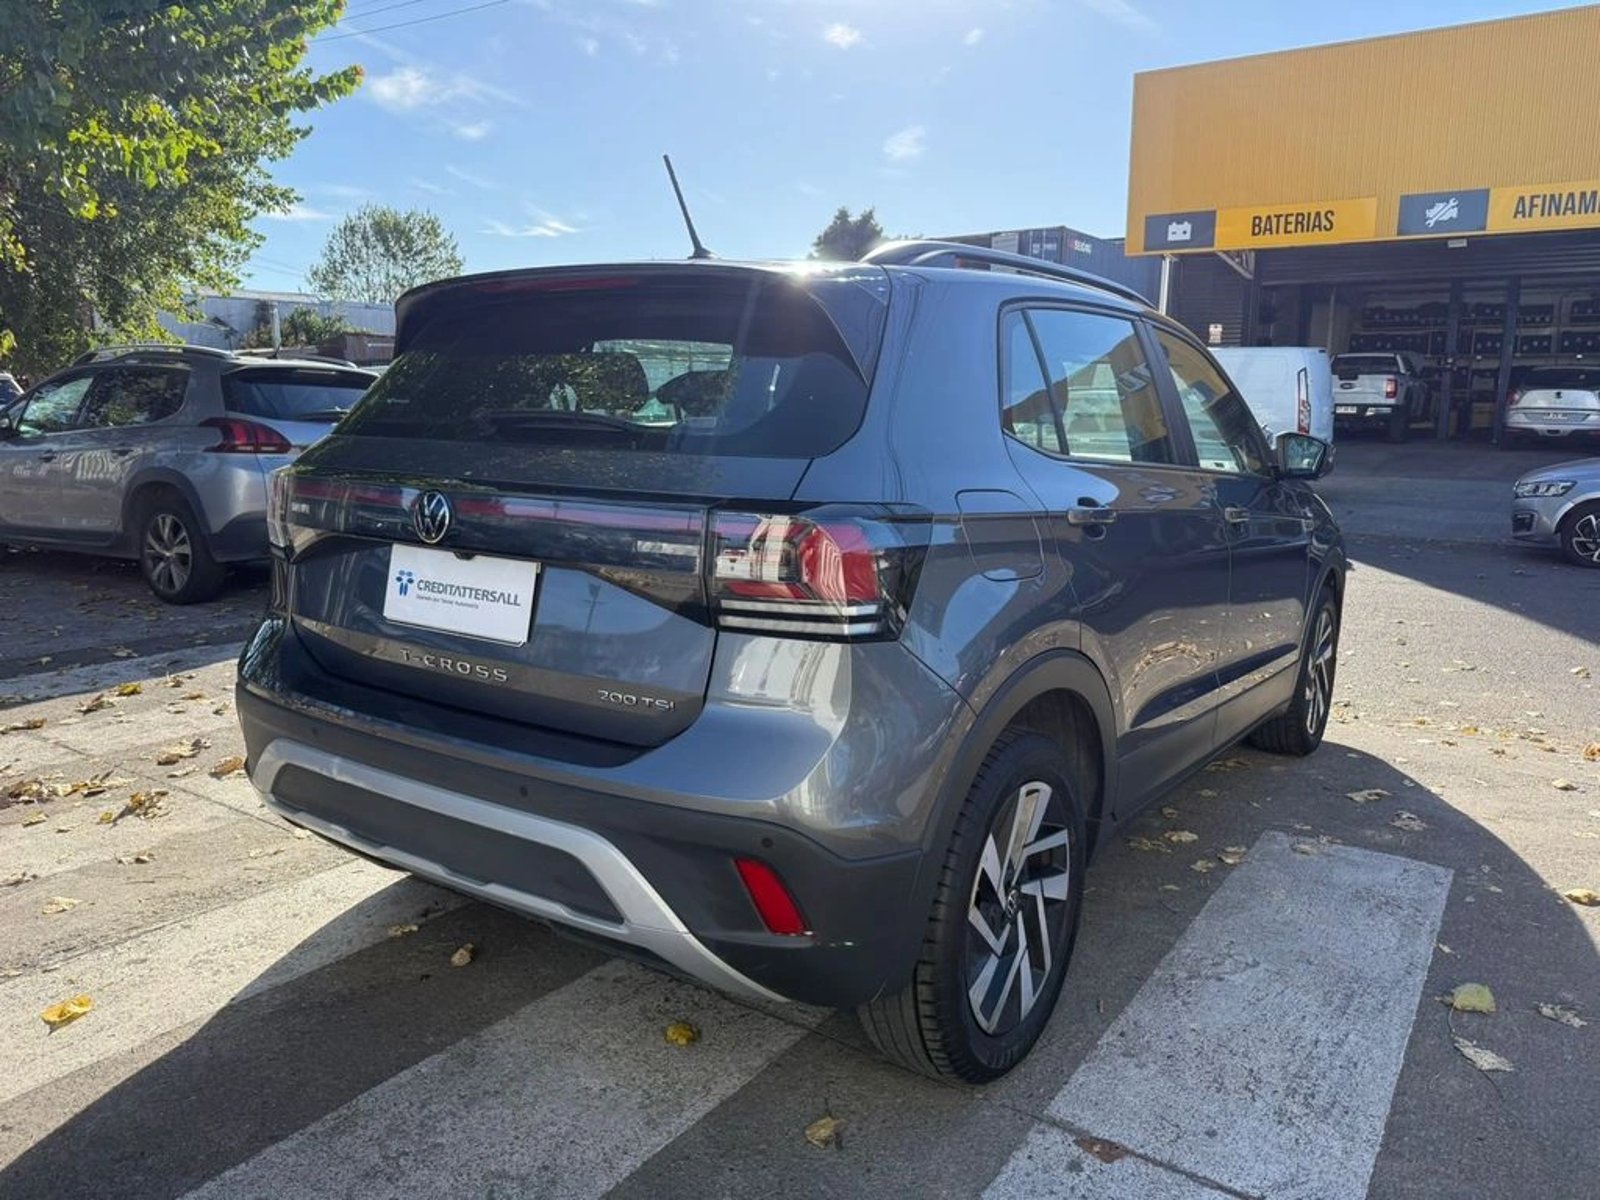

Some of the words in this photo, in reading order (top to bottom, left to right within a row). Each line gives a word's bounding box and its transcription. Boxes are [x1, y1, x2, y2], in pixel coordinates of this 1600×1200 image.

[1513, 190, 1600, 219] AFINAM
[1251, 210, 1335, 237] BATERIAS
[416, 579, 521, 607] CREDITATTERSALL
[400, 648, 508, 682] T-CROSS
[598, 689, 637, 706] 200
[641, 696, 675, 712] TSI
